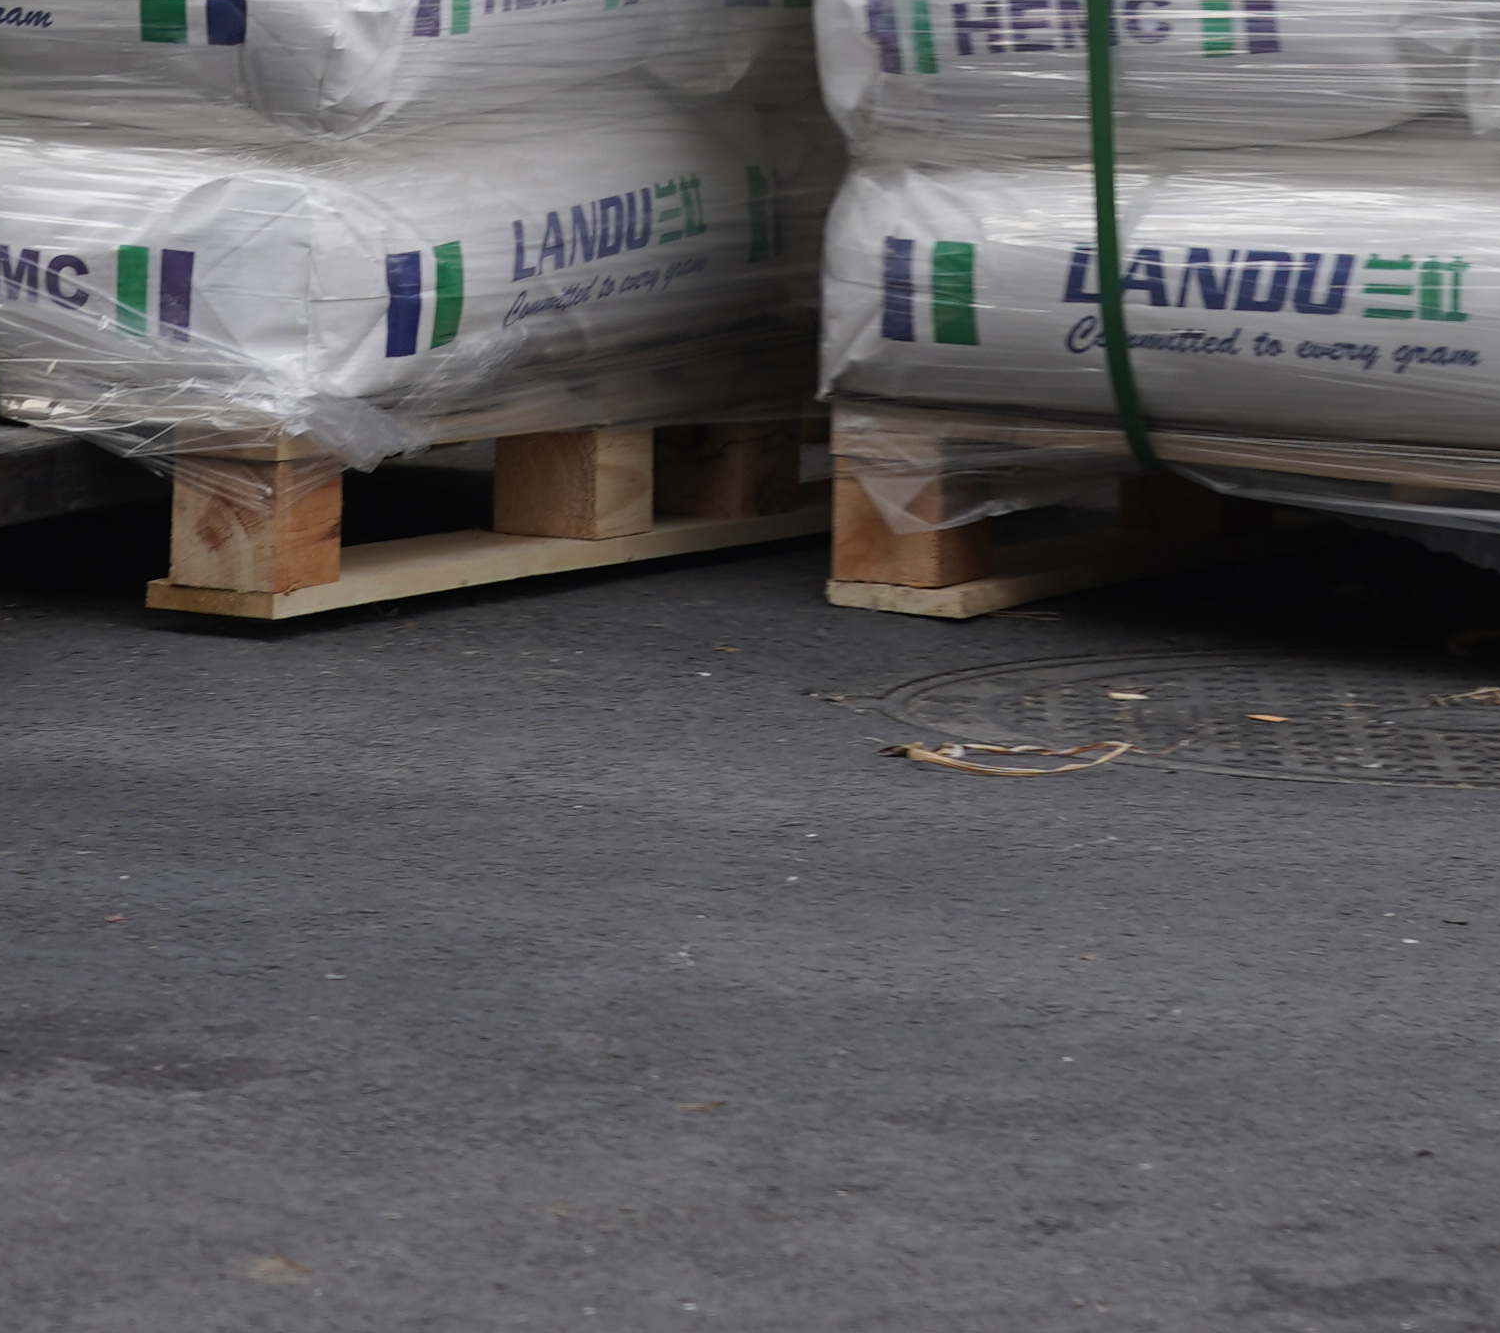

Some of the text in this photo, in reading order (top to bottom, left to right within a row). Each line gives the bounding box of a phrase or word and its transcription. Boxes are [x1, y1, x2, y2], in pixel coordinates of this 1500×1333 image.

[511, 185, 653, 283] LANDU
[502, 276, 599, 329] Committed
[1062, 240, 1358, 316] LANDU
[1253, 332, 1287, 359] to
[1298, 338, 1382, 371] every
[1392, 343, 1486, 376] gram
